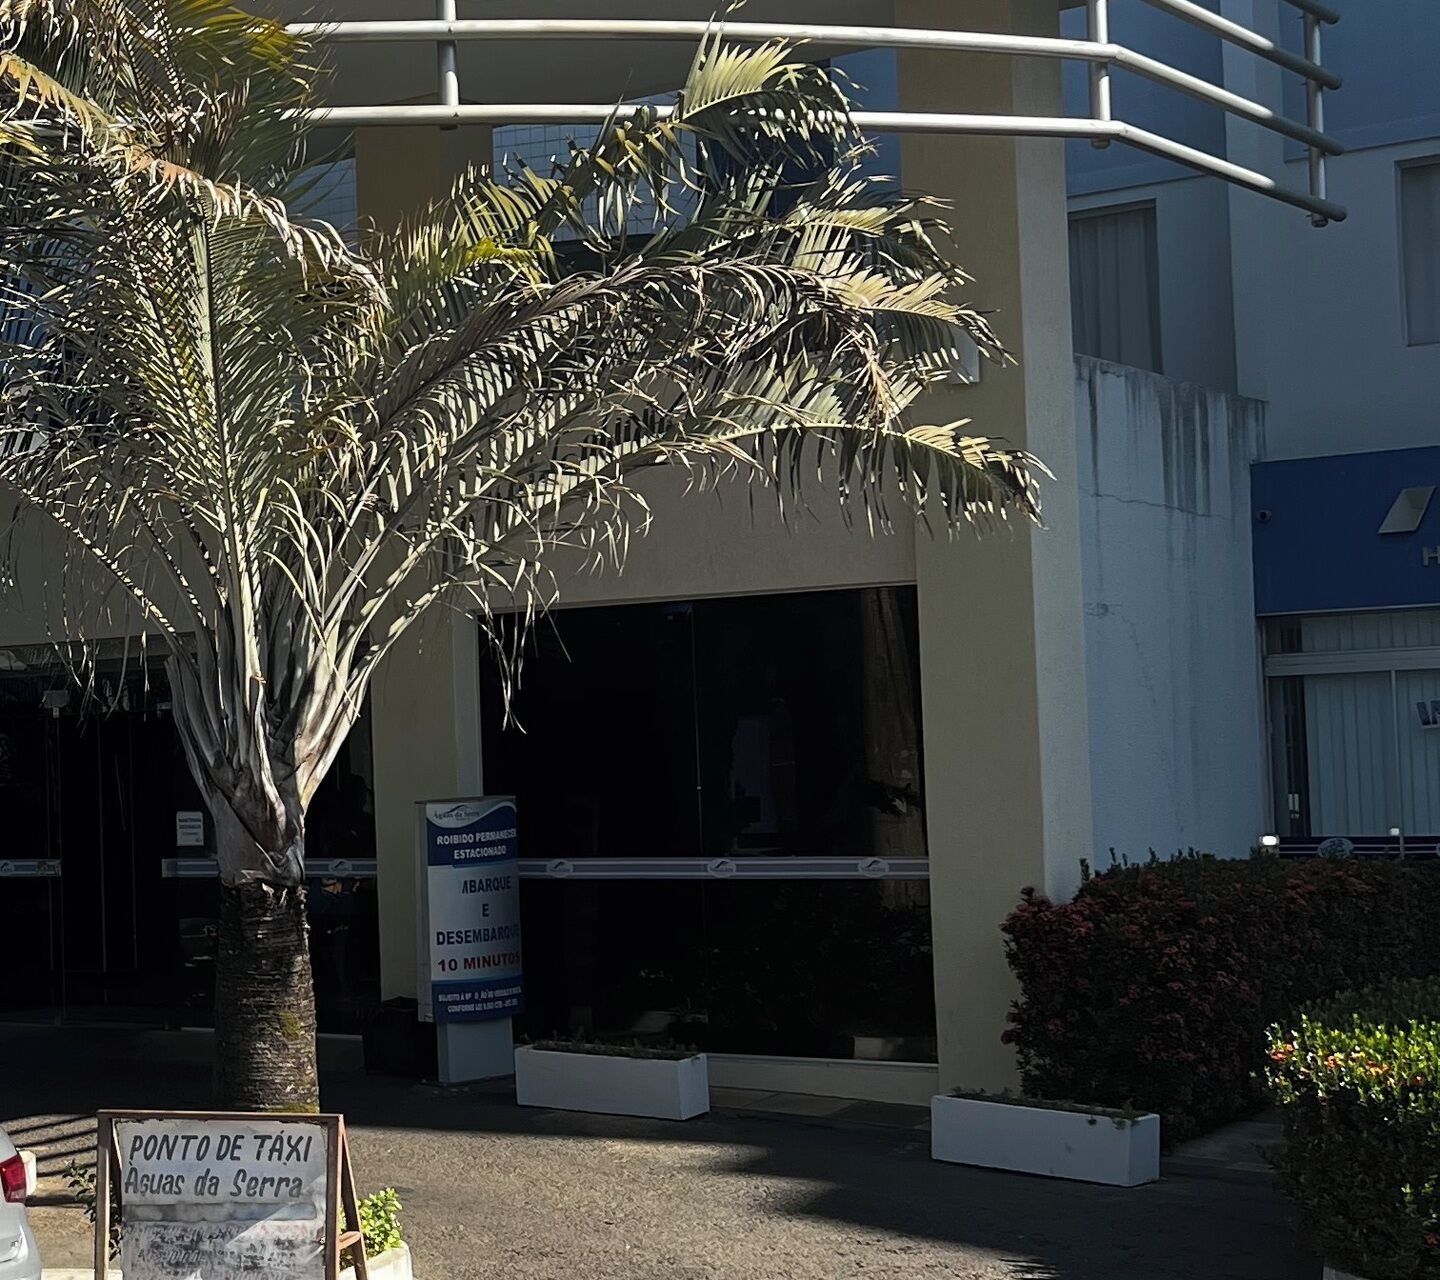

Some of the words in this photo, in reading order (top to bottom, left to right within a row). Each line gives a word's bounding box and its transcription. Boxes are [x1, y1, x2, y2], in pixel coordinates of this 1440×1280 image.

[453, 845, 507, 859] ESTACIONADO
[482, 903, 489, 917] E
[436, 924, 519, 945] DESEMBARQUE
[438, 958, 458, 971] 10
[463, 951, 520, 970] MINUTOS
[129, 1133, 211, 1162] PONTO
[215, 1133, 245, 1162] DE
[253, 1129, 313, 1163] TÁXI
[193, 1167, 220, 1197] da
[230, 1168, 303, 1198] Serra
